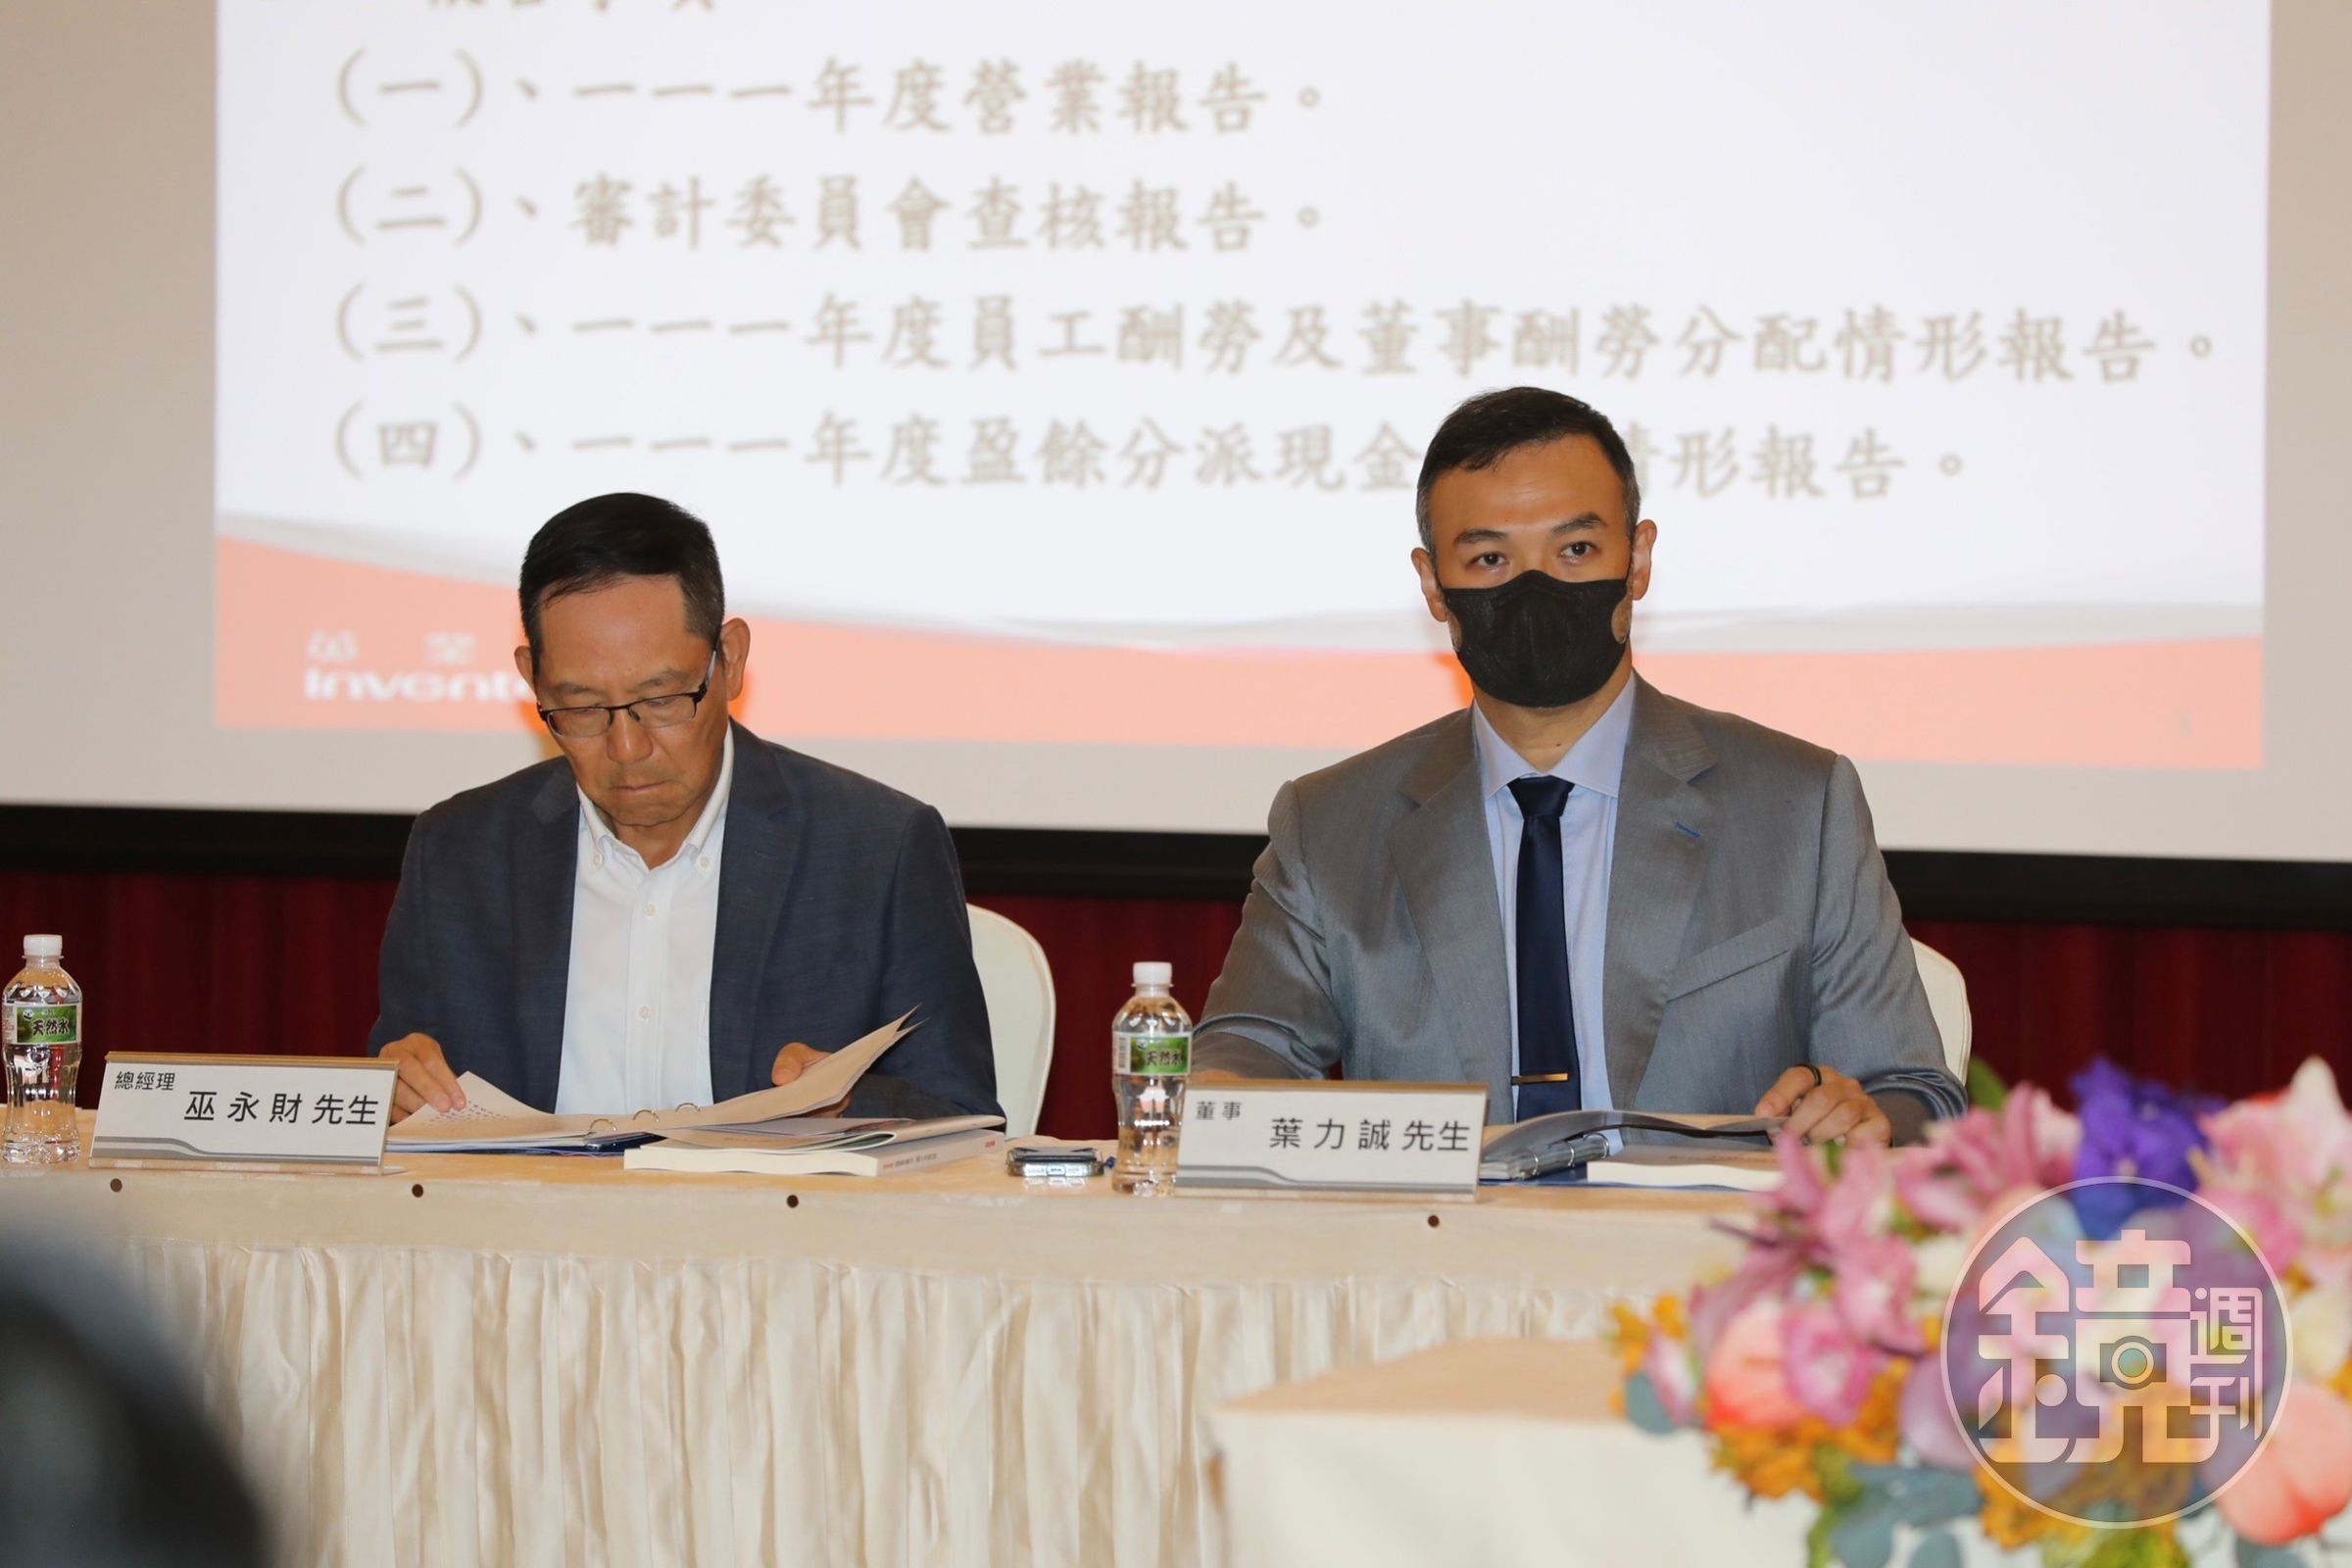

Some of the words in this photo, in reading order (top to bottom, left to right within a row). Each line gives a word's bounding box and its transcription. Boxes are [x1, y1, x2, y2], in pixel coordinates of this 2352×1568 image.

[114, 1070, 175, 1091] 總經理
[183, 1091, 379, 1126] 巫永財先生
[1196, 1101, 1242, 1120] 董事
[1270, 1117, 1470, 1152] 葉力誠先生
